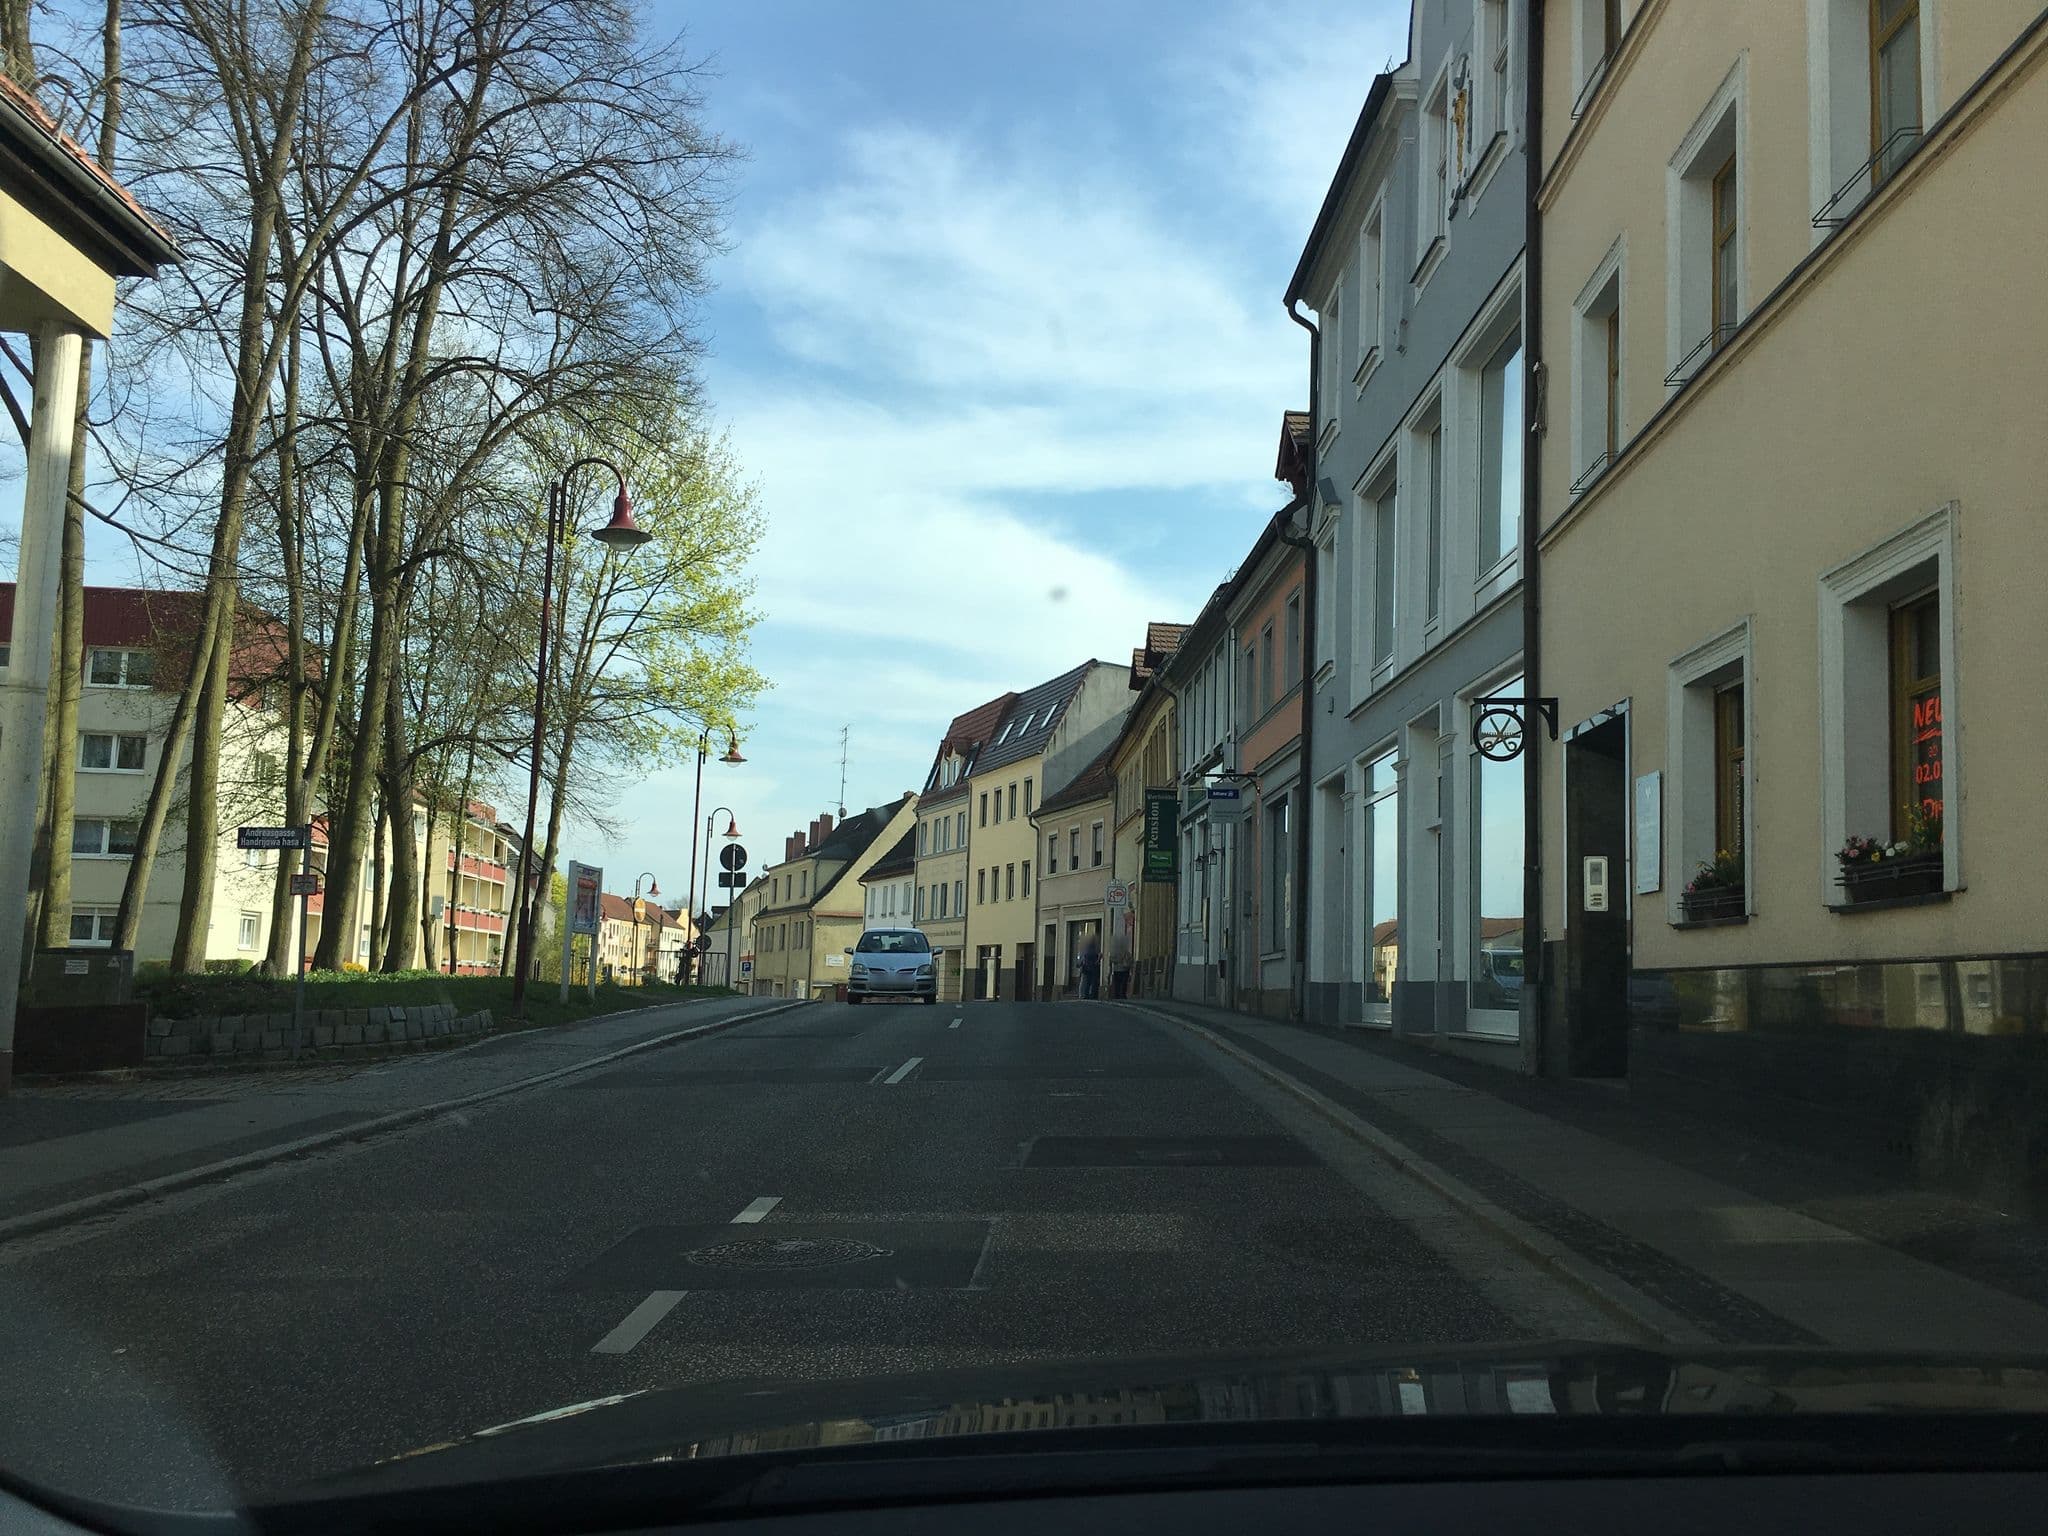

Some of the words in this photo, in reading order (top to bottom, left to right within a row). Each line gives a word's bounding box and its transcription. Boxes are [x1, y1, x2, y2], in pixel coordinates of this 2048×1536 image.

[1915, 760, 1943, 784] 02.0
[245, 829, 295, 838] Andreasgasse
[1148, 801, 1159, 849] Pension
[241, 837, 281, 847] Handrijowa
[282, 837, 299, 846] hasa
